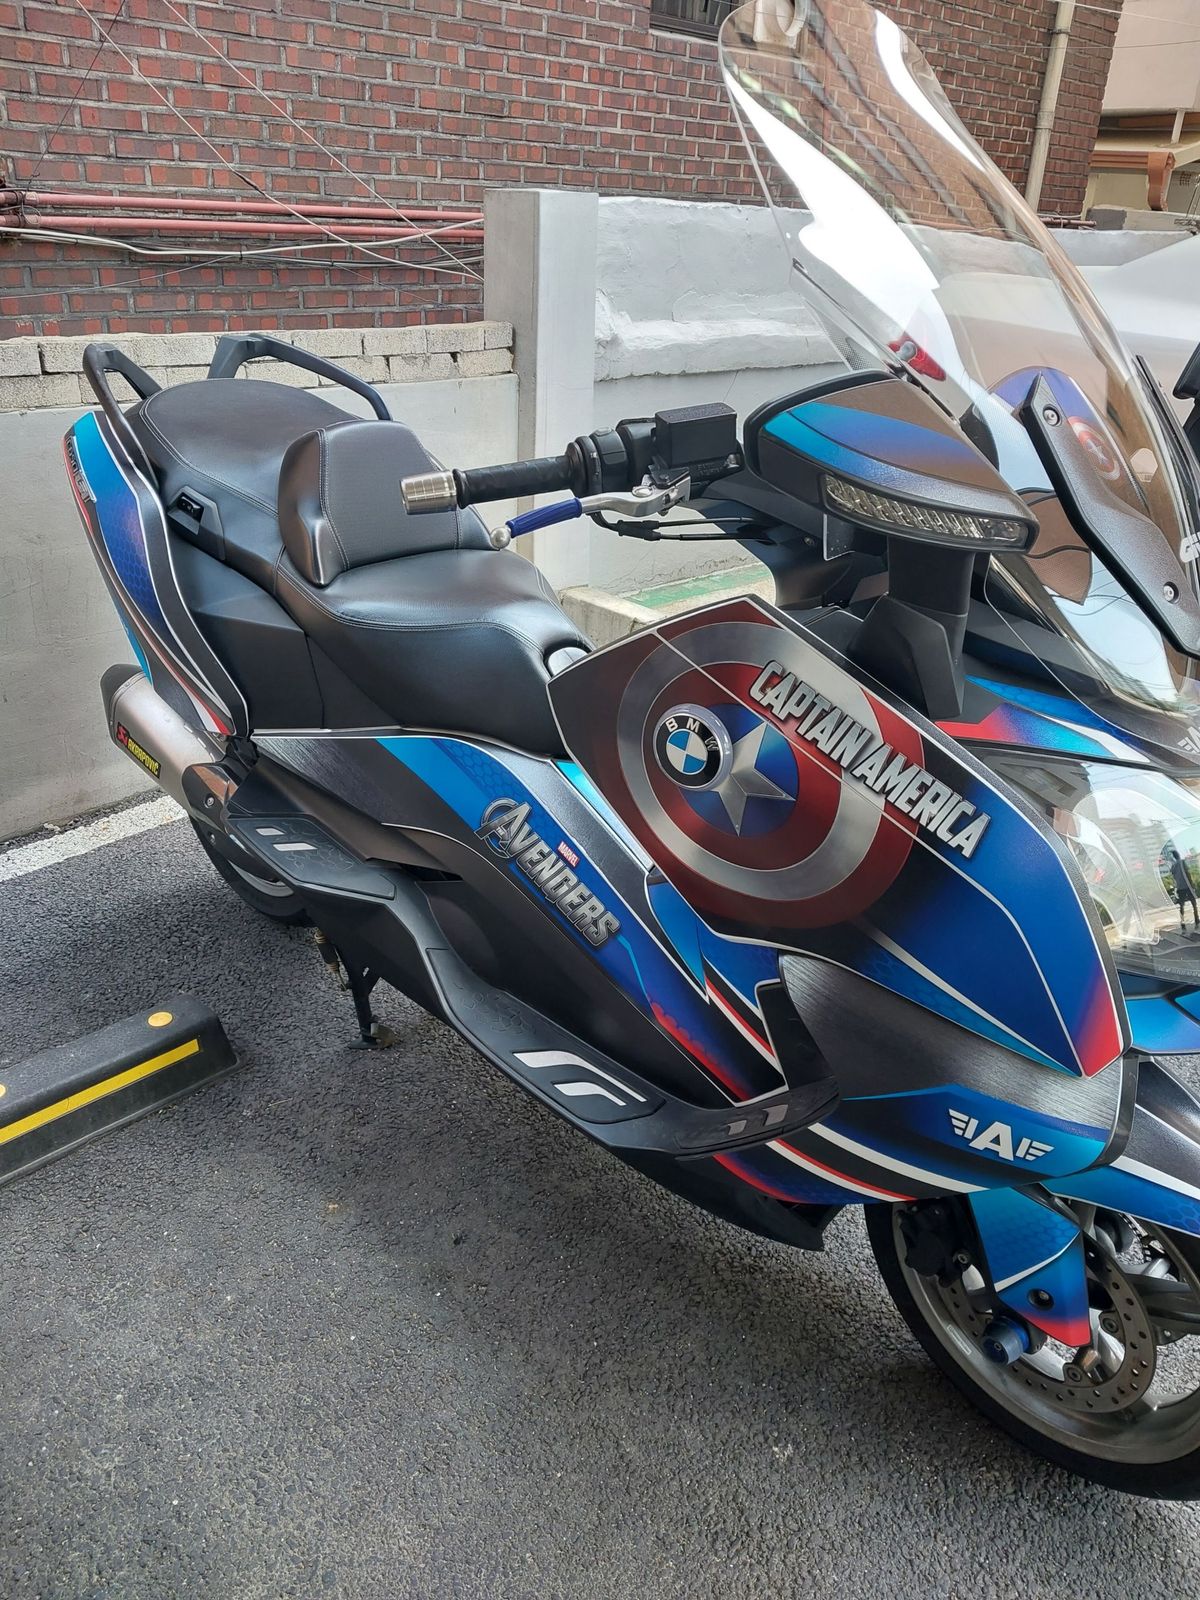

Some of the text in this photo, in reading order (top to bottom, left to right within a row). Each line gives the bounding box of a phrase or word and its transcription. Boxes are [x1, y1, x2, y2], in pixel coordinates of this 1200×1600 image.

[665, 717, 719, 752] BMW
[749, 659, 991, 858] CAPTAIN AMERICA
[474, 797, 621, 946] AVENGERS
[557, 840, 580, 868] MARVEL
